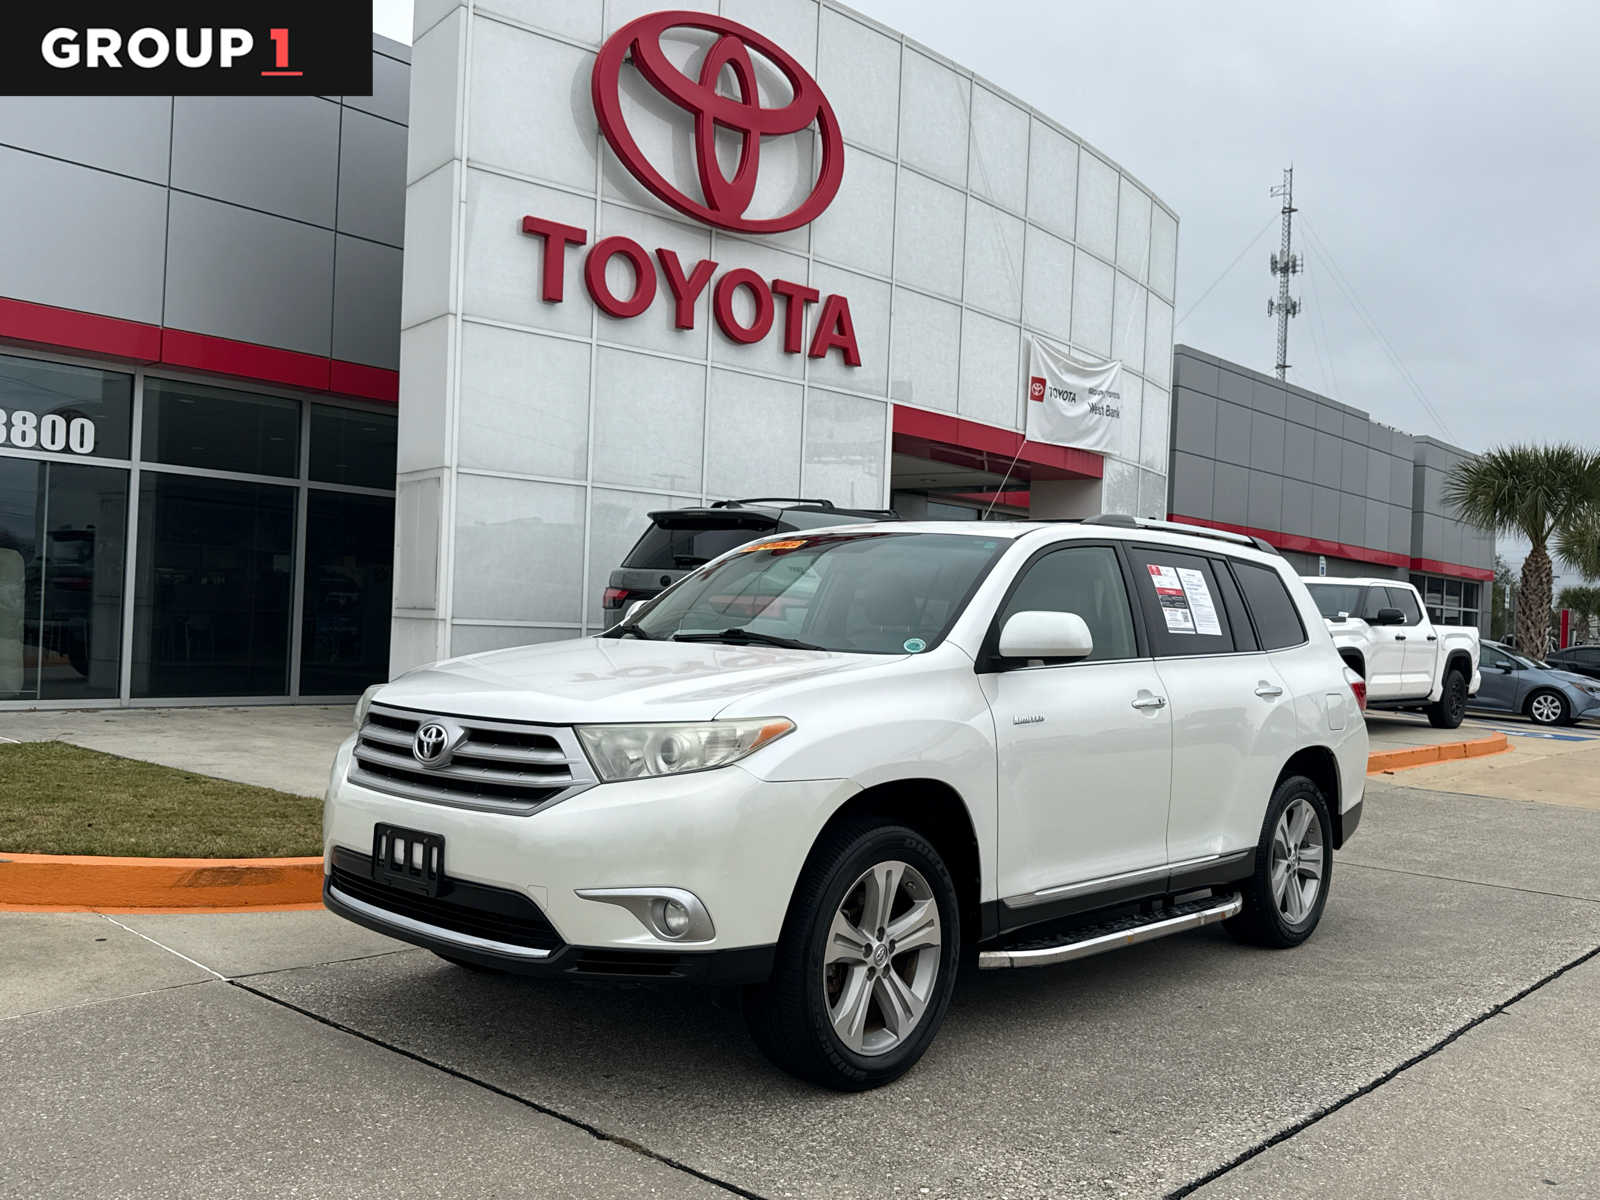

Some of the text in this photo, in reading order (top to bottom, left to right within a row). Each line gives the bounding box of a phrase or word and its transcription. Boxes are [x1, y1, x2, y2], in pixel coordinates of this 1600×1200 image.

[522, 215, 861, 367] TOYOTA
[1048, 386, 1077, 403] TOYOTA
[1088, 401, 1120, 418] West Bank
[0, 408, 95, 454] 800
